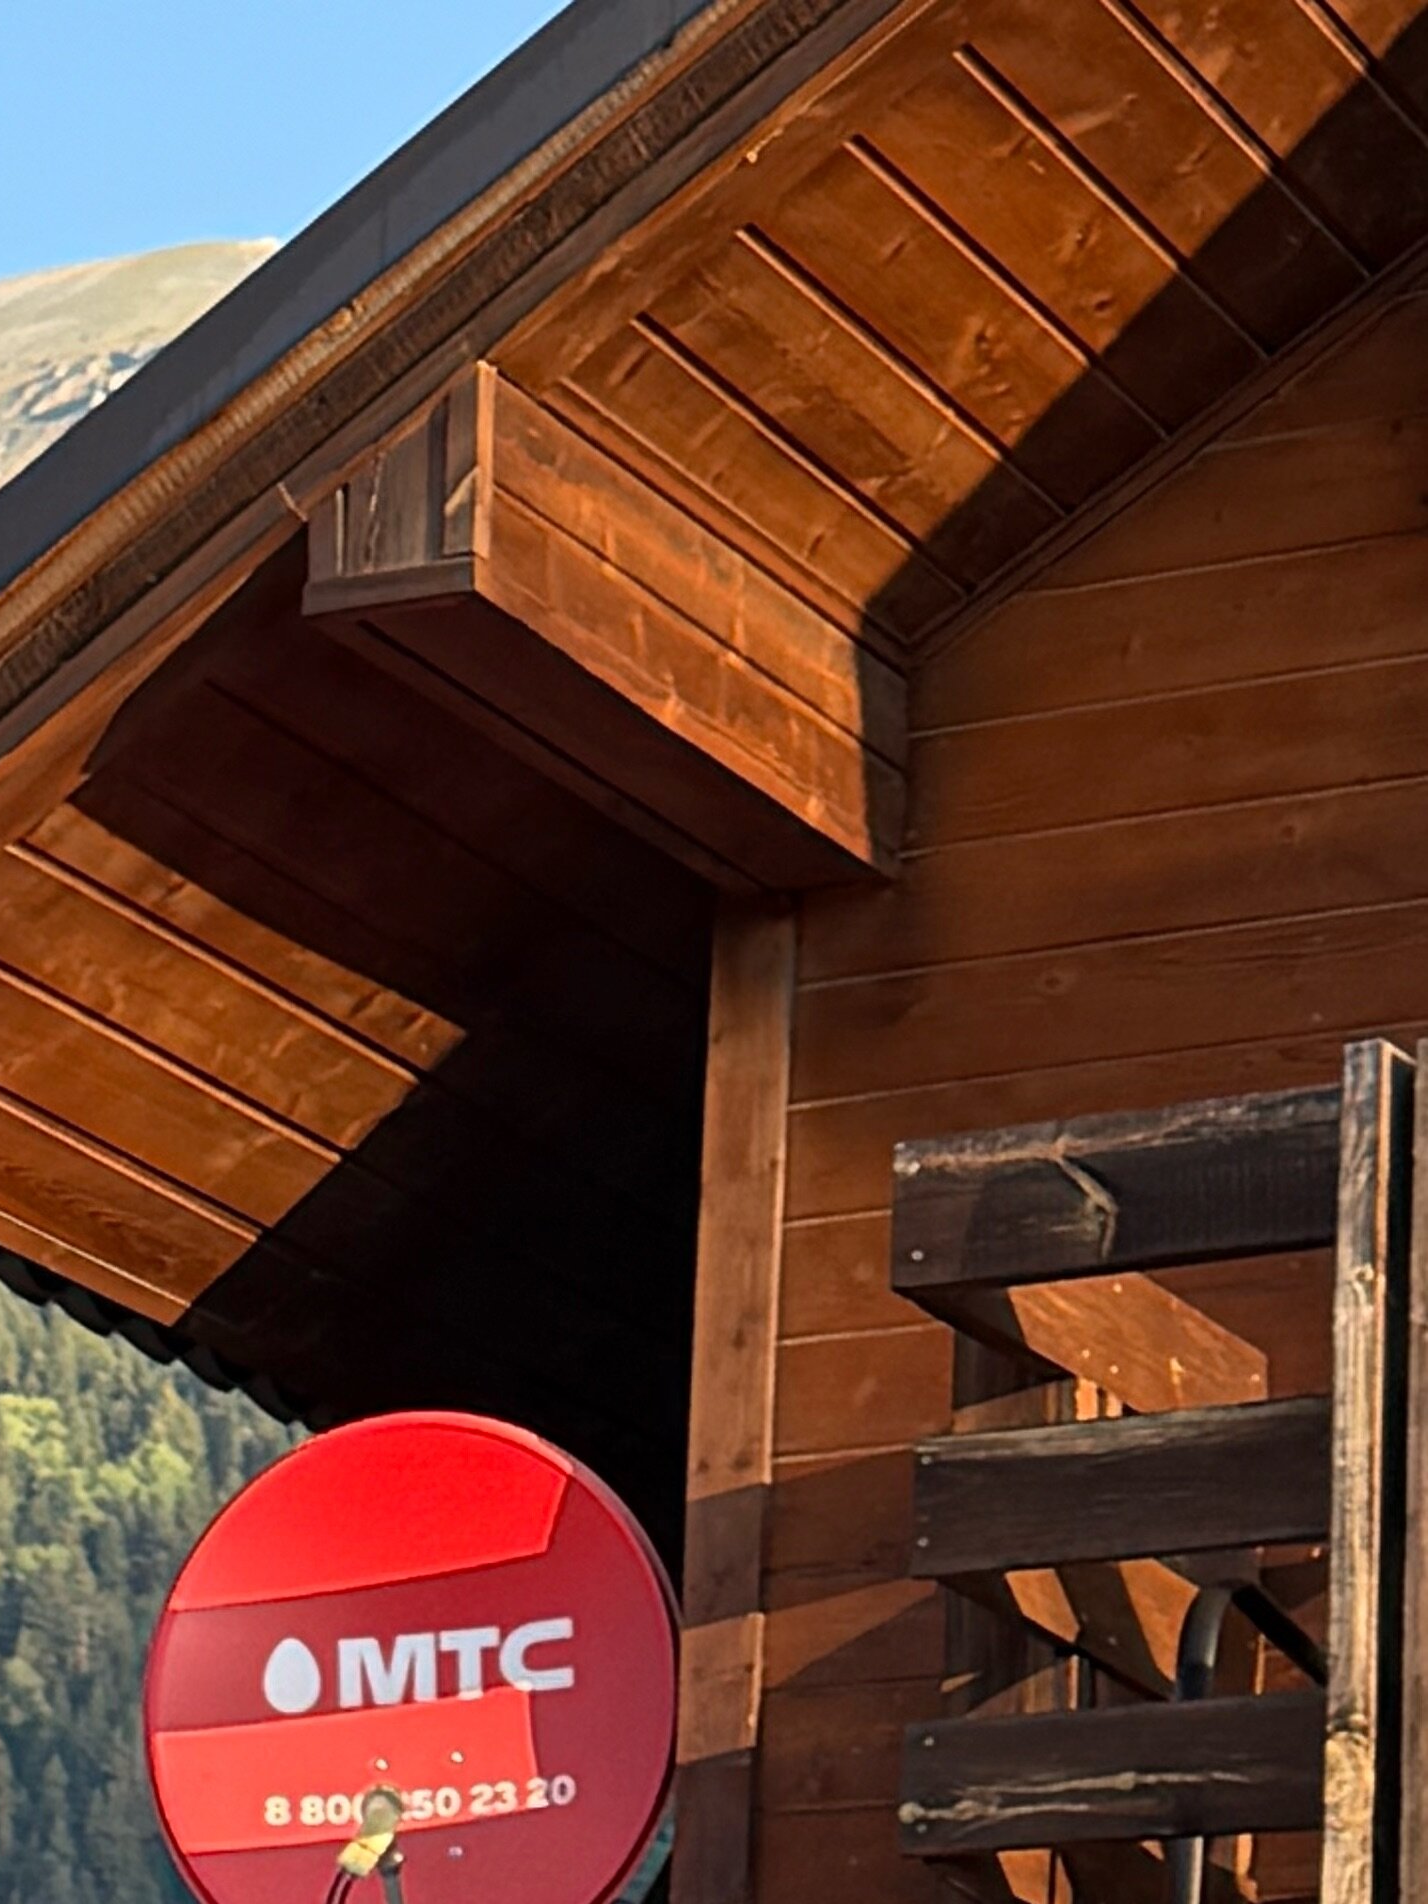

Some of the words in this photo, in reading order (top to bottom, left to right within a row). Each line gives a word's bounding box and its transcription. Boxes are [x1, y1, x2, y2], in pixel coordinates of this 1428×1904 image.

[338, 1617, 574, 1708] МТС
[264, 1795, 291, 1826] 8
[469, 1780, 519, 1815] 23
[525, 1774, 577, 1808] 20
